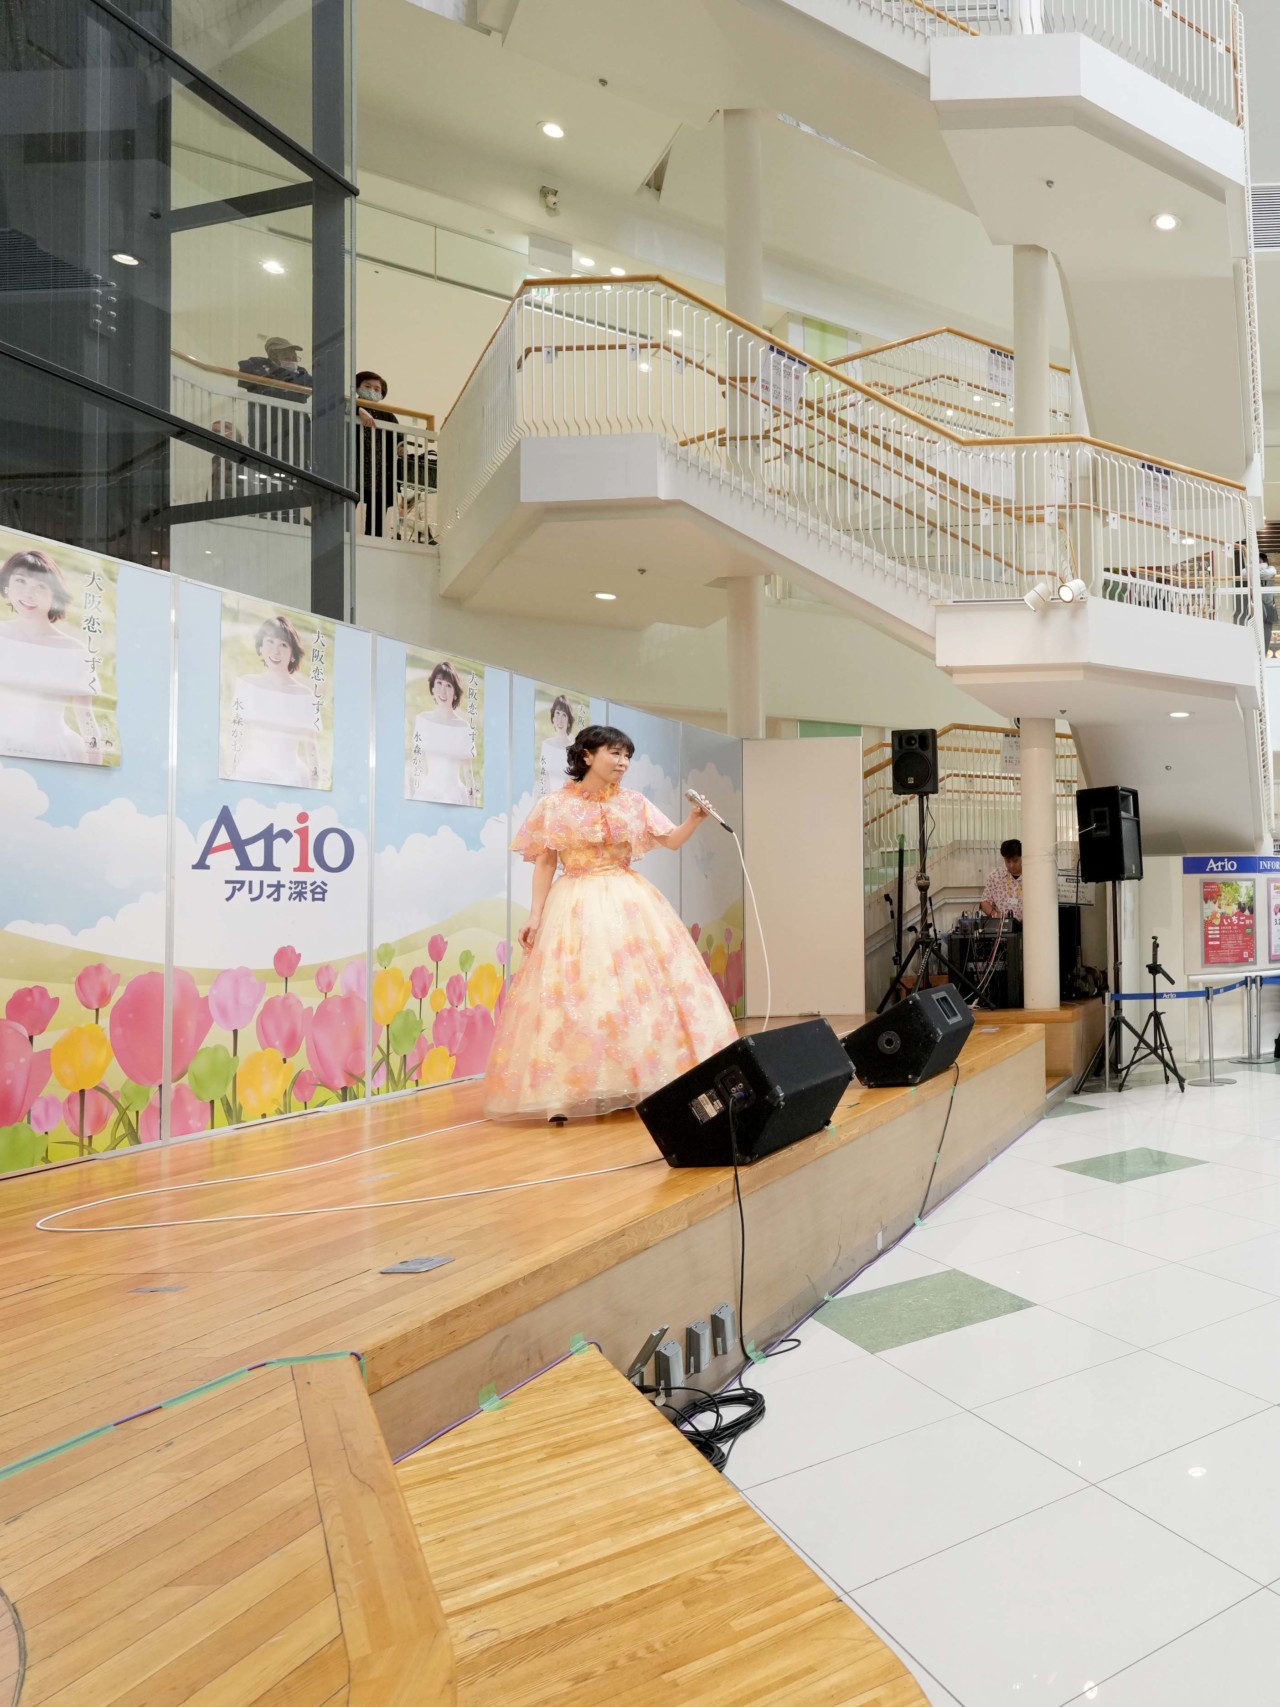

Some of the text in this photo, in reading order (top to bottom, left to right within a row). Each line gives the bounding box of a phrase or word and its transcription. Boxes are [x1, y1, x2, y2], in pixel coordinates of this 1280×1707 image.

[83, 571, 102, 694] 大阪恋しずく
[311, 630, 325, 732] 大阪恋しずく
[468, 672, 478, 758] 大阪恋しずく
[192, 805, 354, 873] Ario
[1206, 858, 1237, 871] Ario
[224, 879, 328, 902] アリオ深谷
